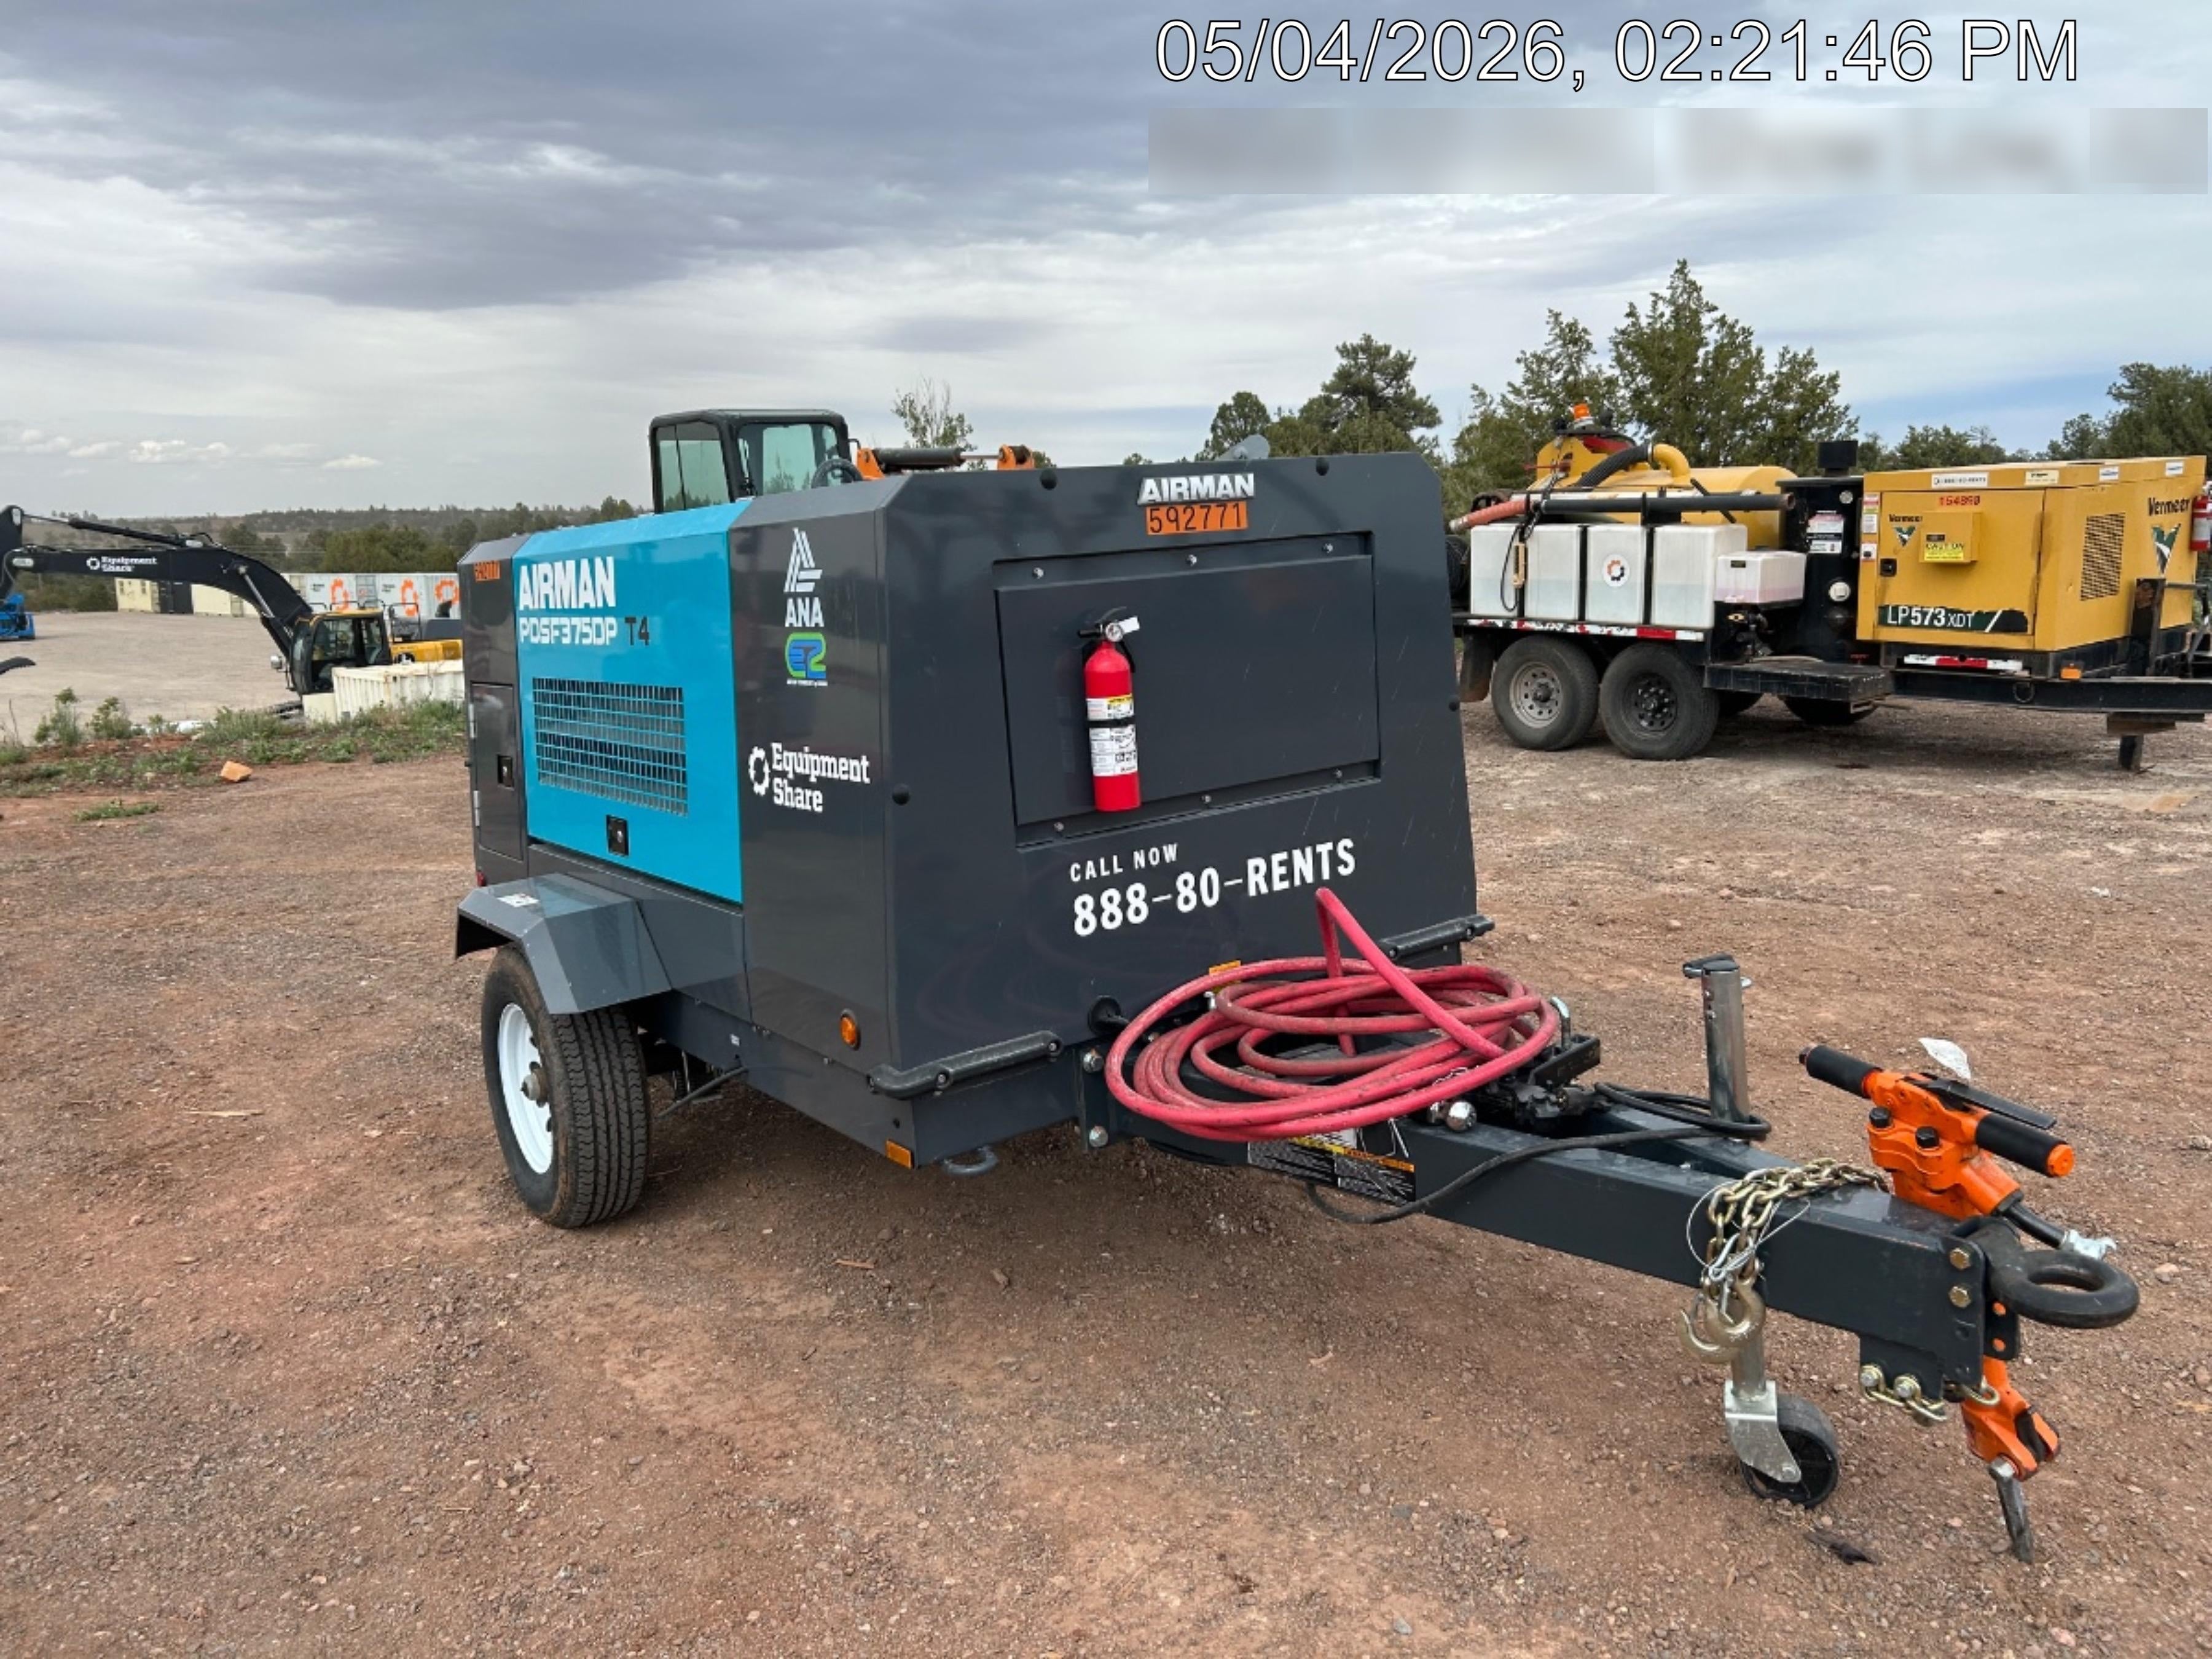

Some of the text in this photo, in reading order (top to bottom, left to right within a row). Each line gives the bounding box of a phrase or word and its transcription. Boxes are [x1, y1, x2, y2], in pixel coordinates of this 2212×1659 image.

[1137, 473, 1254, 506] AIRMAN
[2148, 496, 2190, 517] Vermeer
[1150, 503, 1241, 533] 592771
[519, 555, 616, 611] AIRMAN
[785, 597, 825, 627] ANA
[624, 616, 649, 646] T4
[771, 742, 871, 785] Equipment
[772, 777, 823, 813] Share
[1070, 842, 1179, 882] CALL NOW
[1073, 837, 1356, 937] 888-80-RENTS
